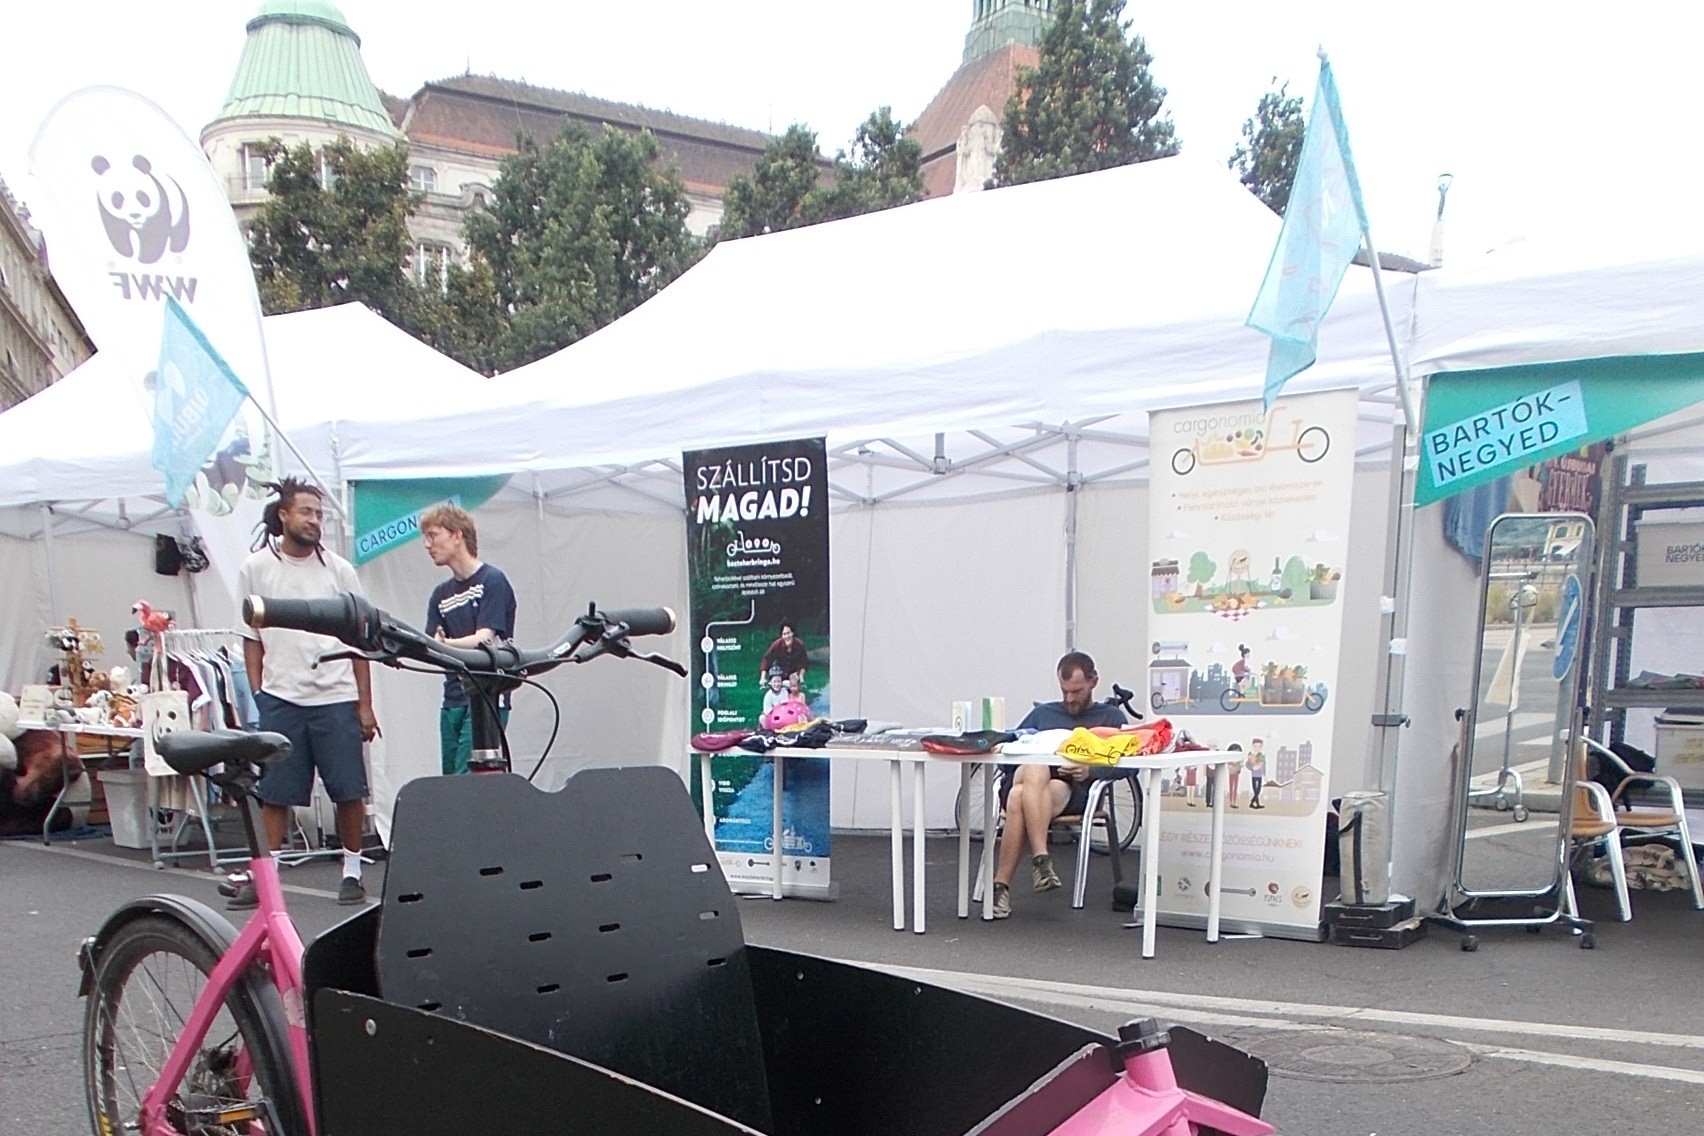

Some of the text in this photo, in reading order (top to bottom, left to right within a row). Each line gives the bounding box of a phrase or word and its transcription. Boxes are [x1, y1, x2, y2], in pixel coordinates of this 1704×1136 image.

[1438, 421, 1559, 481] NEGYED
[696, 456, 812, 490] SZÁLLÍTSD
[696, 486, 811, 524] MAGAD!
[1181, 850, 1274, 863] www.cgonomia.hu
